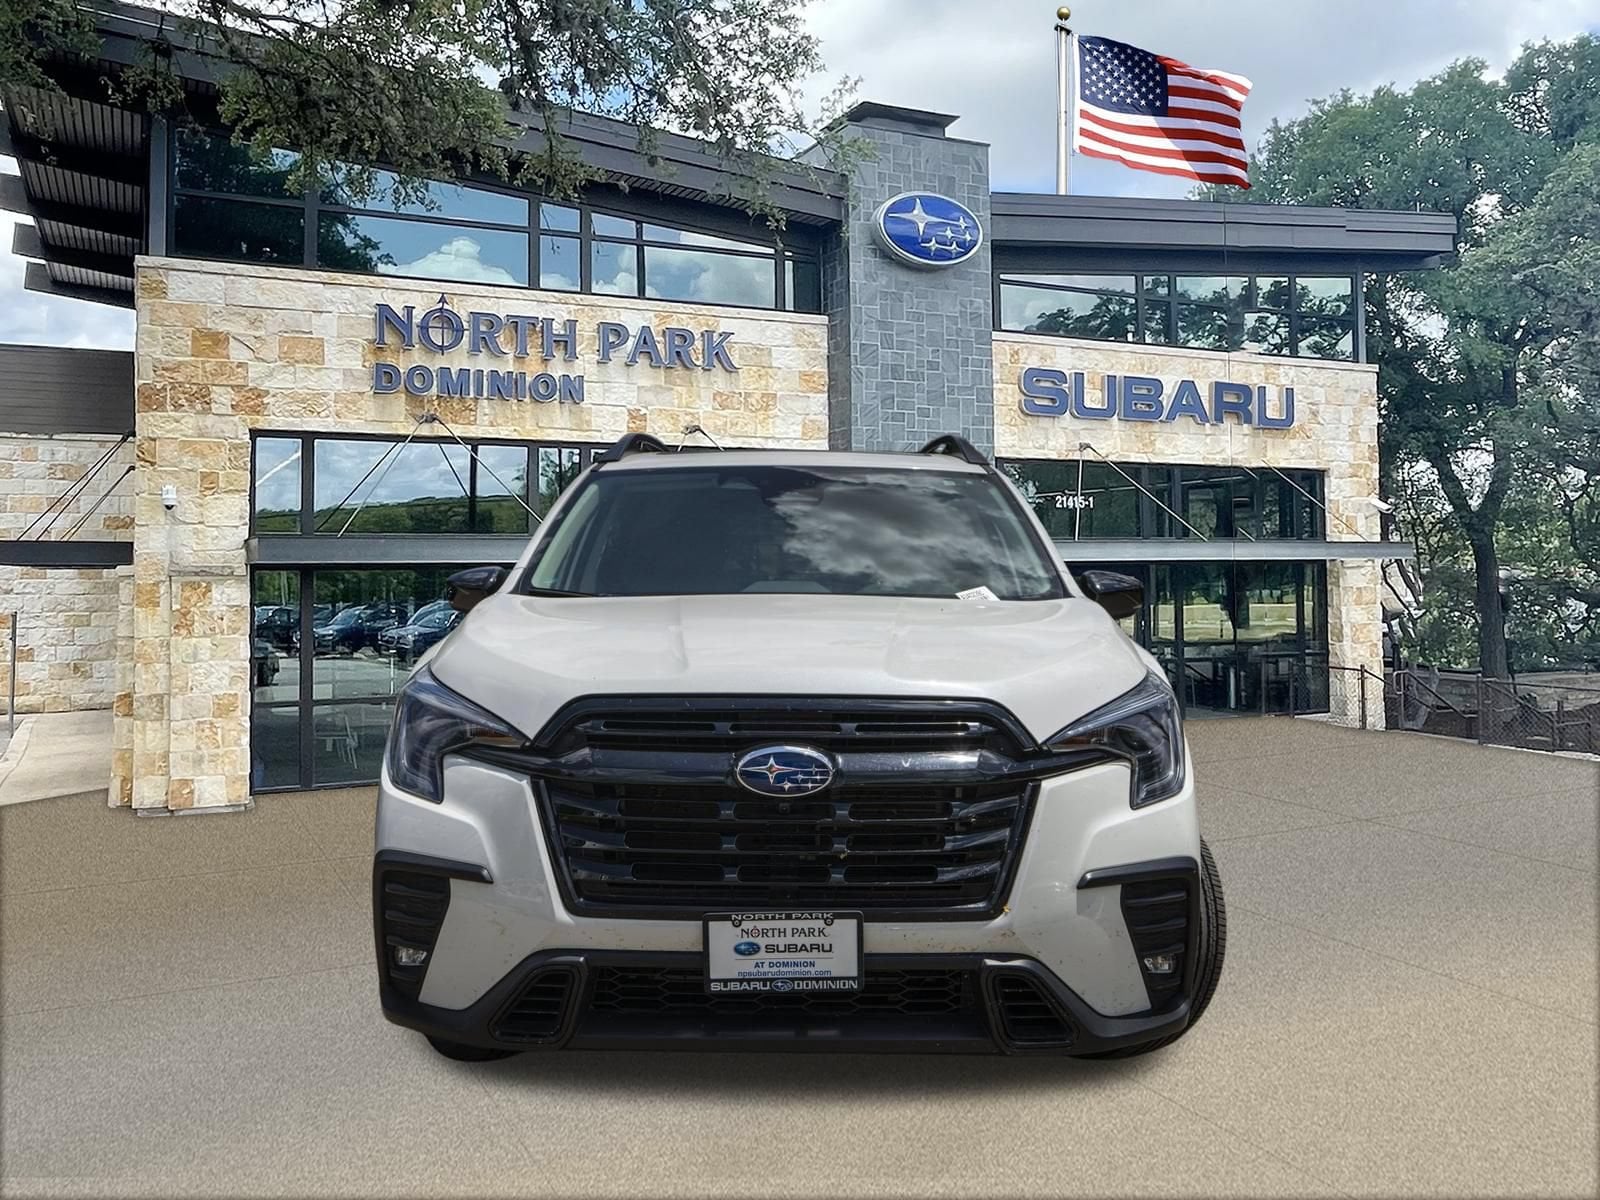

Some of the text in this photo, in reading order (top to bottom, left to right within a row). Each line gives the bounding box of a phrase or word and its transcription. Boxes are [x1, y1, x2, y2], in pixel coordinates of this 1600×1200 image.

[374, 293, 742, 373] NORTH PARK
[373, 362, 585, 404] DOMINION
[1018, 367, 1295, 430] SUBARU
[731, 912, 834, 921] NORTH PARK
[740, 926, 828, 939] NORTH PARK
[764, 943, 833, 954] SUBARU
[768, 960, 816, 968] DOMINION
[737, 969, 832, 978] npsubarudominion.com
[710, 980, 858, 991] SUBARU DOMINION
